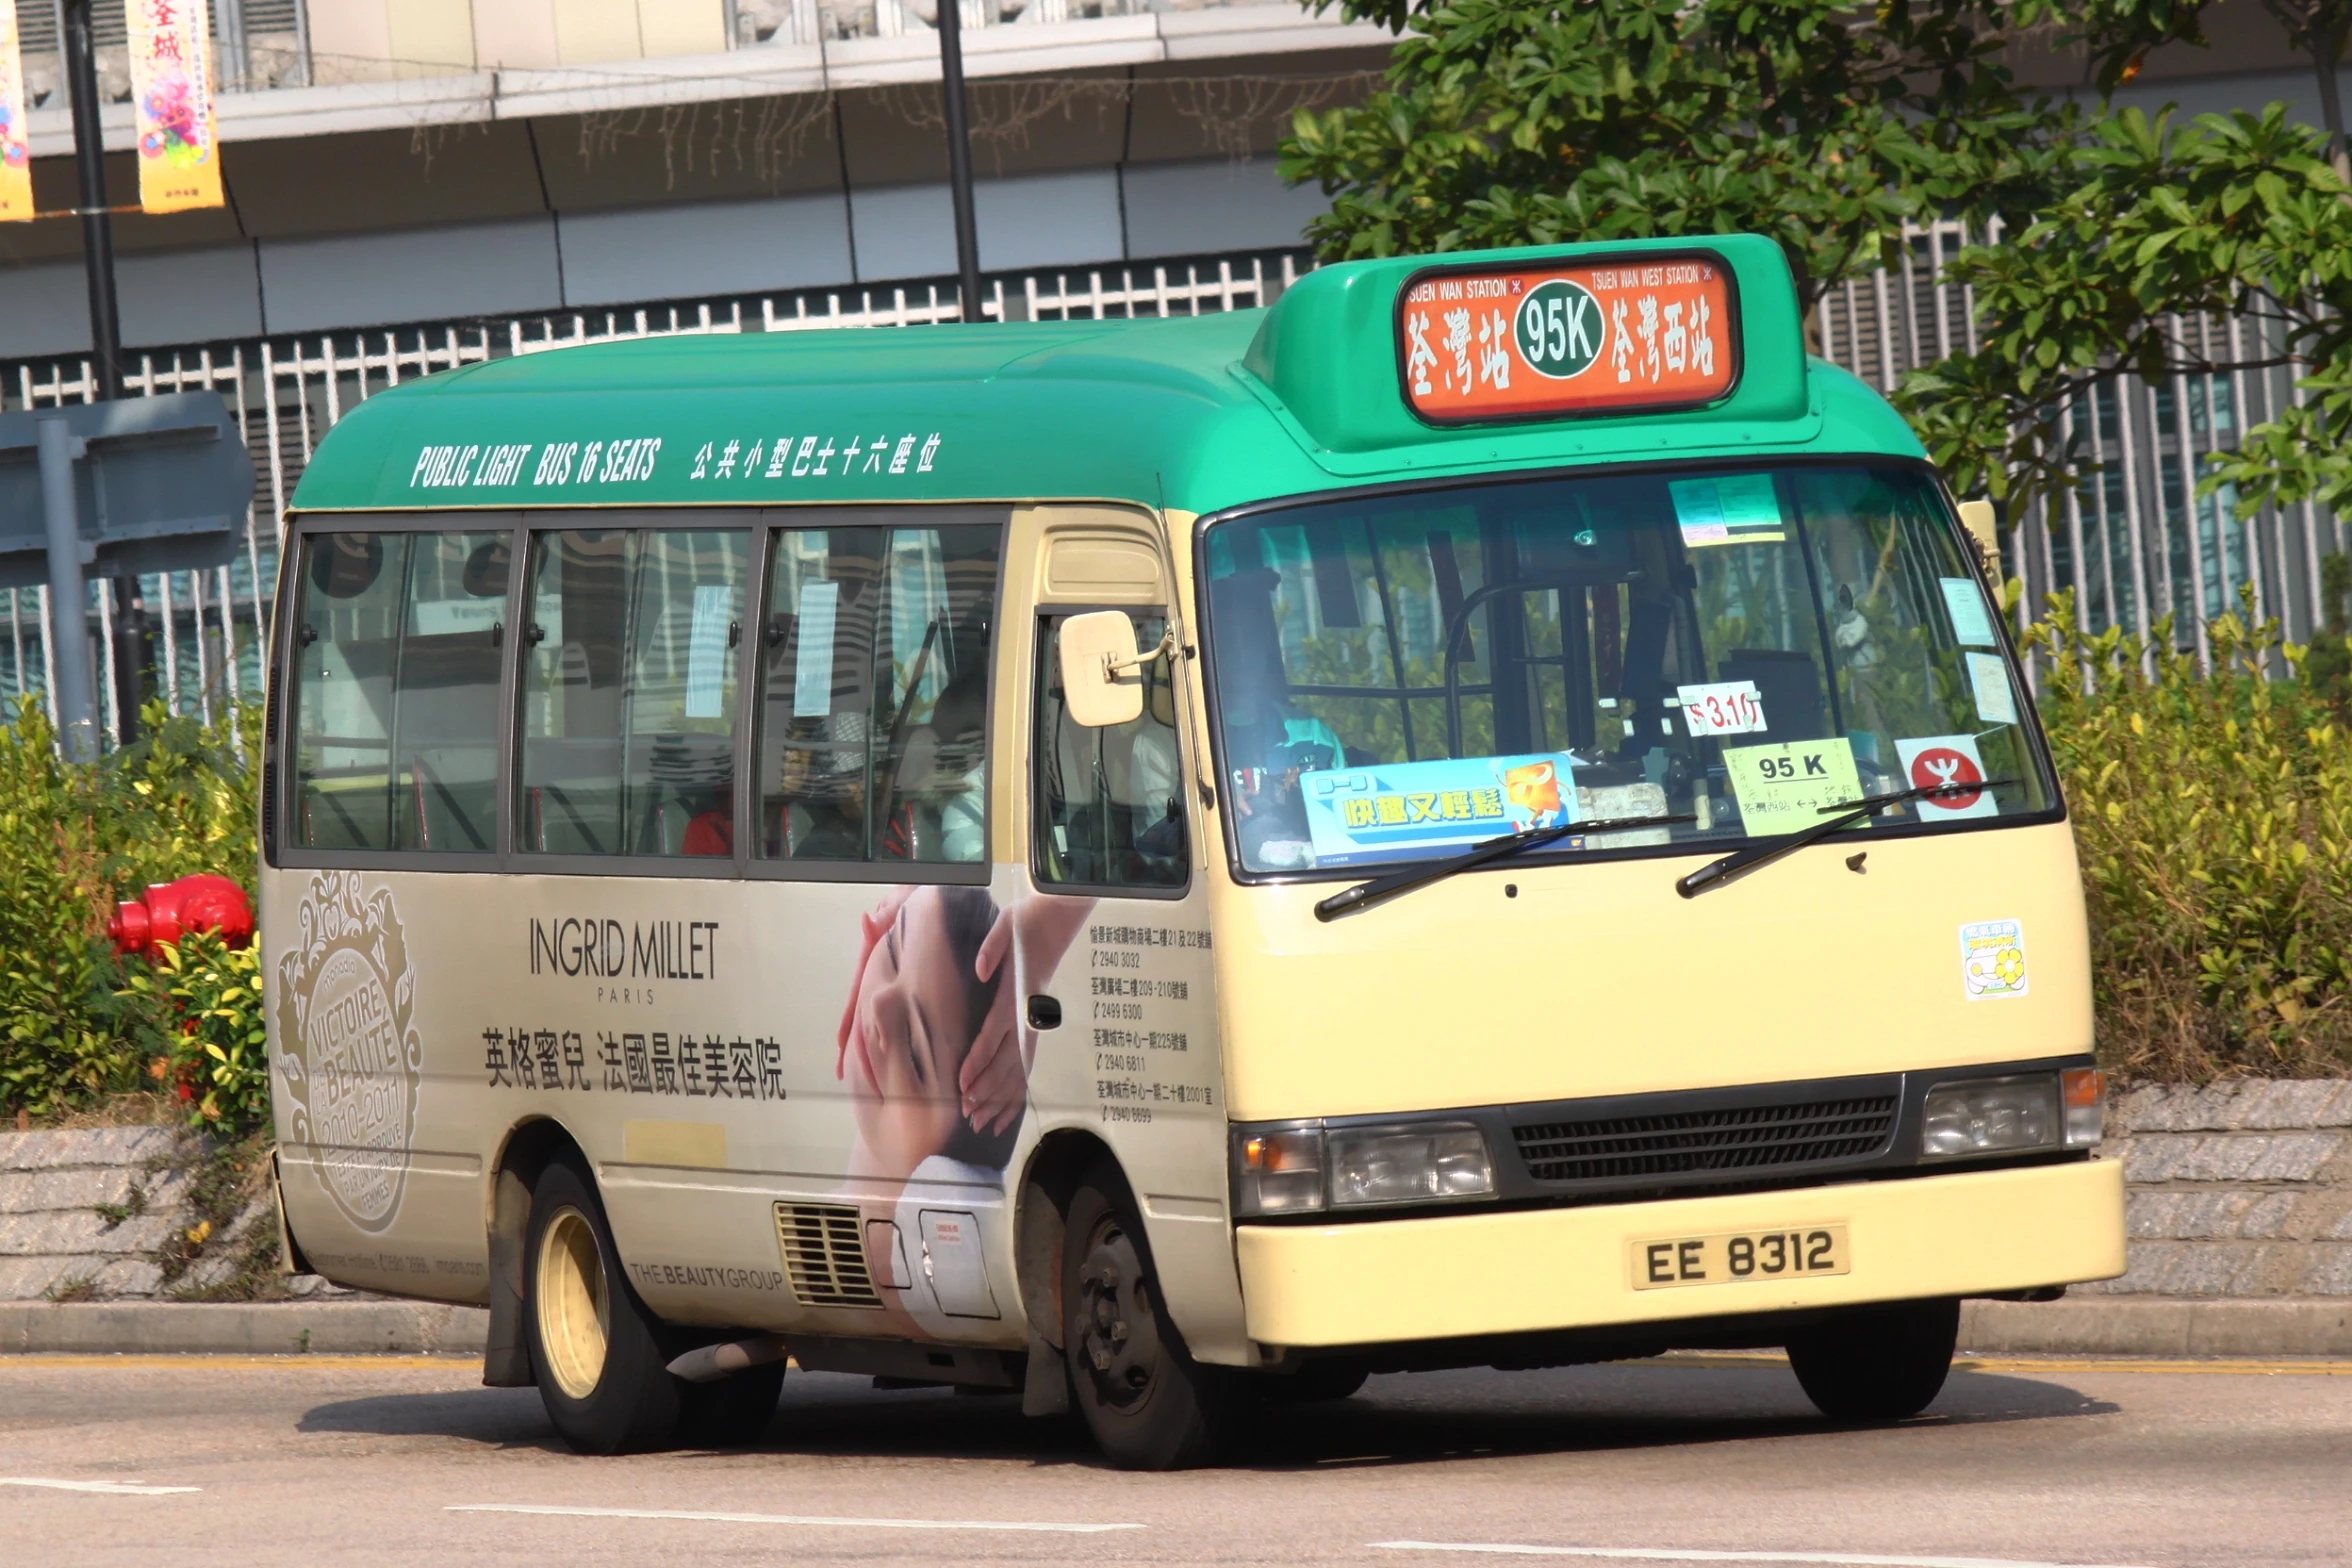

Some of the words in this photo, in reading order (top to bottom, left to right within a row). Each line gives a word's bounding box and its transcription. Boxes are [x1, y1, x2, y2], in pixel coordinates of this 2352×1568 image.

[1439, 282, 1463, 299] WAN
[1466, 278, 1507, 298] STATION
[1591, 270, 1618, 291] TSUEN
[1620, 269, 1639, 288] WAN
[1641, 267, 1664, 286] WEST
[1666, 265, 1699, 285] STATION
[1406, 307, 1510, 396] 荃灣站
[1526, 294, 1594, 363] 95K
[1611, 293, 1714, 384] 荃灣西站
[410, 445, 476, 488] PUBLIC
[472, 443, 532, 487] LIGHT
[533, 442, 577, 486] BUS
[576, 441, 600, 484] 16
[600, 437, 662, 483] SEATS
[690, 432, 941, 480] 公共小型巴士十六座位
[1758, 756, 1795, 779] 95
[1804, 754, 1828, 776] K
[1343, 787, 1505, 830] 快趣又輕鬆
[529, 917, 625, 978] INGRID
[631, 920, 720, 980] MILLET
[1099, 951, 1119, 967] 2940
[1121, 952, 1140, 968] 3032
[310, 978, 382, 1057] VICTOIRE
[597, 986, 655, 1005] PARIS
[1101, 1002, 1121, 1019] 2499
[1122, 1004, 1143, 1020] 6300
[324, 1006, 397, 1107] BEAUTÉ
[482, 1025, 592, 1092] 英格蜜兒
[596, 1030, 787, 1100] 法國最佳美容院
[1104, 1054, 1125, 1070] 2940
[1126, 1055, 1146, 1072] 6811
[321, 1075, 399, 1157] 2010-2011
[1646, 1240, 1706, 1283] EE
[1727, 1230, 1835, 1276] 8312
